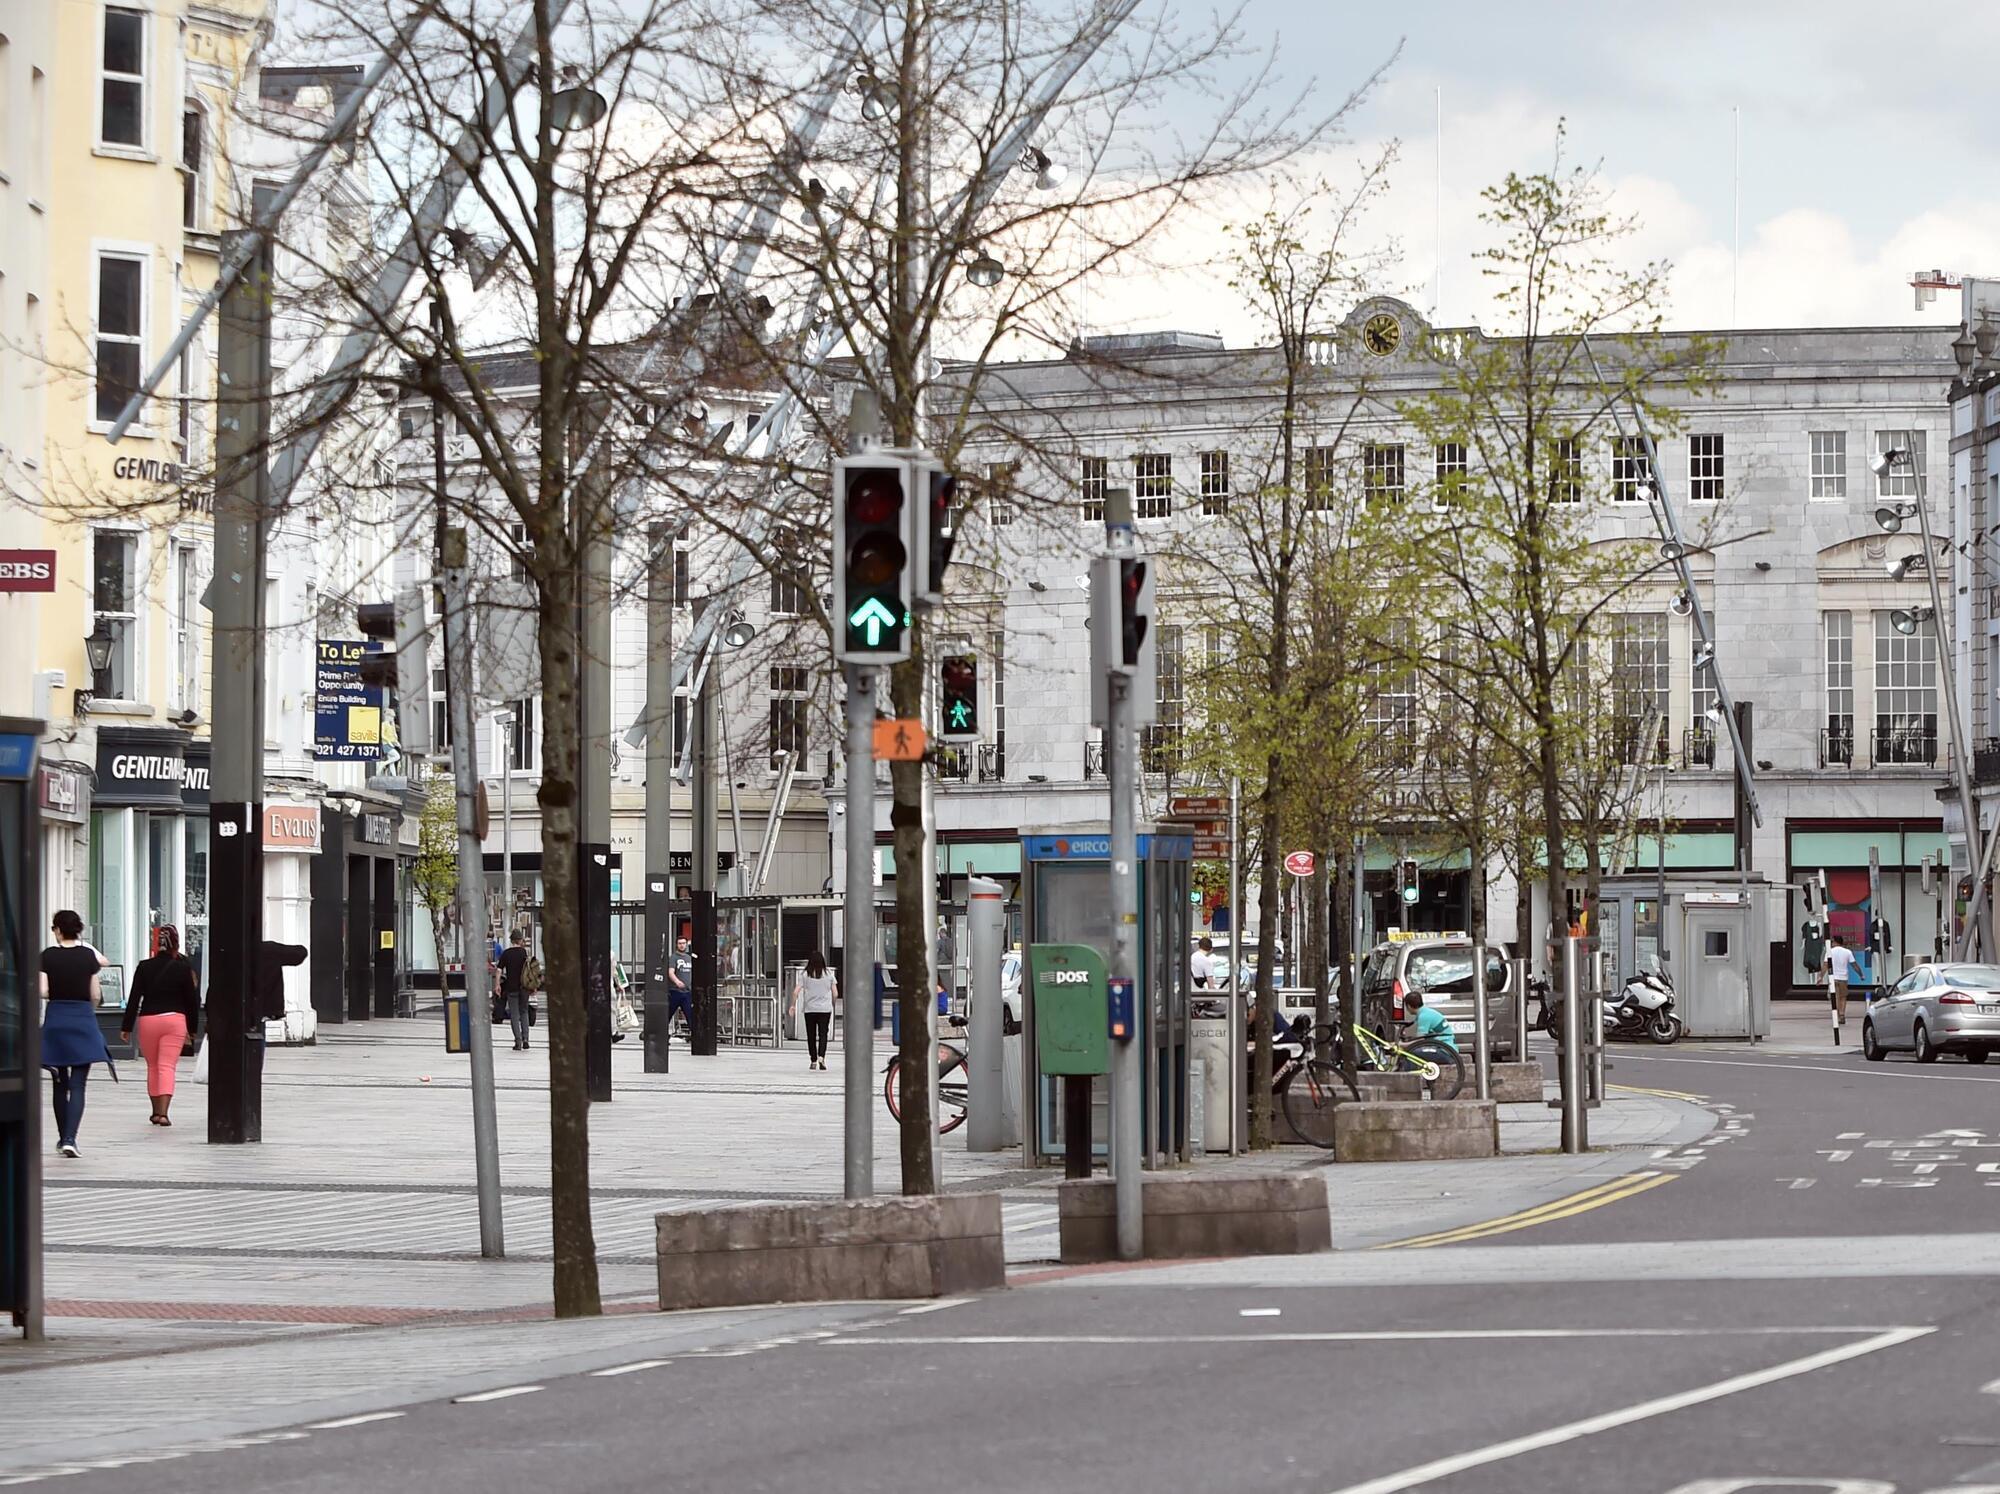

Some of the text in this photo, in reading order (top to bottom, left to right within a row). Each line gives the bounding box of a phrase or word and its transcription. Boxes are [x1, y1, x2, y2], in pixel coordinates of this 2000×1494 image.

[0, 562, 50, 579] EBS
[319, 643, 338, 658] To
[318, 670, 342, 680] Prime
[318, 680, 365, 691] Oppotunity
[339, 695, 366, 705] Building
[350, 730, 378, 741] savills
[317, 745, 380, 757] 021 427 1371
[271, 813, 316, 838] Evans
